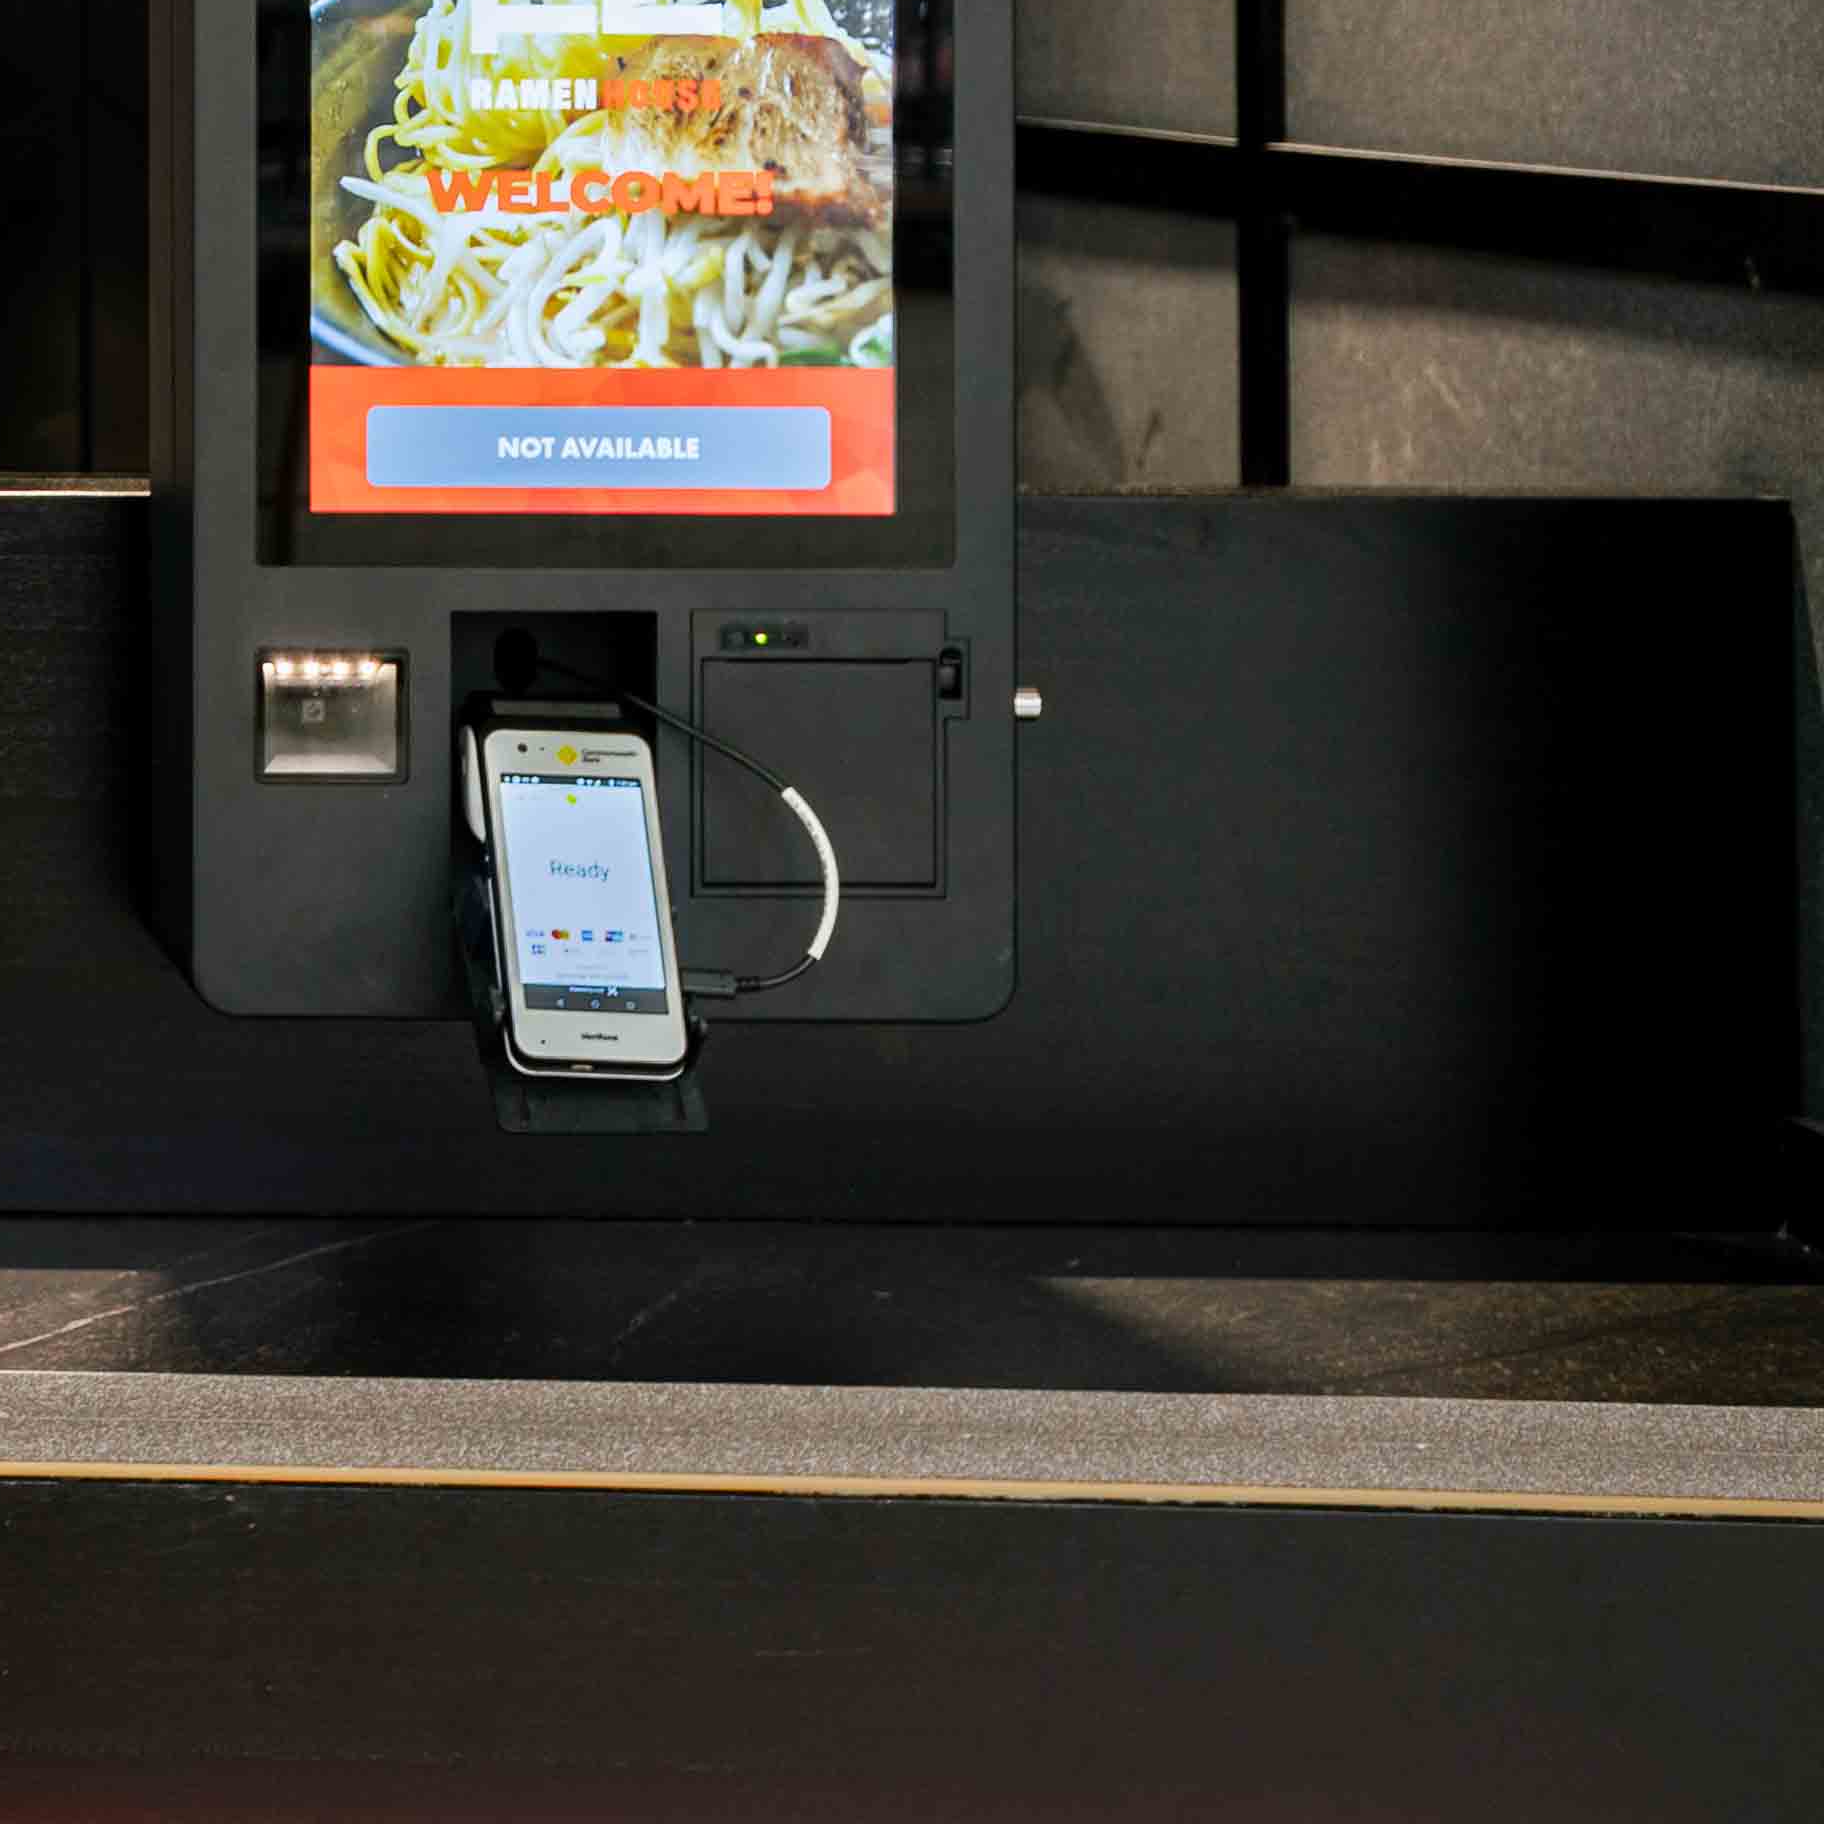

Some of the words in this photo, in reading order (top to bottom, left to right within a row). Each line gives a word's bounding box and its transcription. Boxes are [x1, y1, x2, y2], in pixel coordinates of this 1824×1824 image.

[470, 79, 598, 111] RAMEN
[426, 169, 776, 217] WELCOME!
[497, 436, 554, 460] NOT
[561, 436, 700, 461] AVAILABLE
[549, 860, 610, 882] Ready
